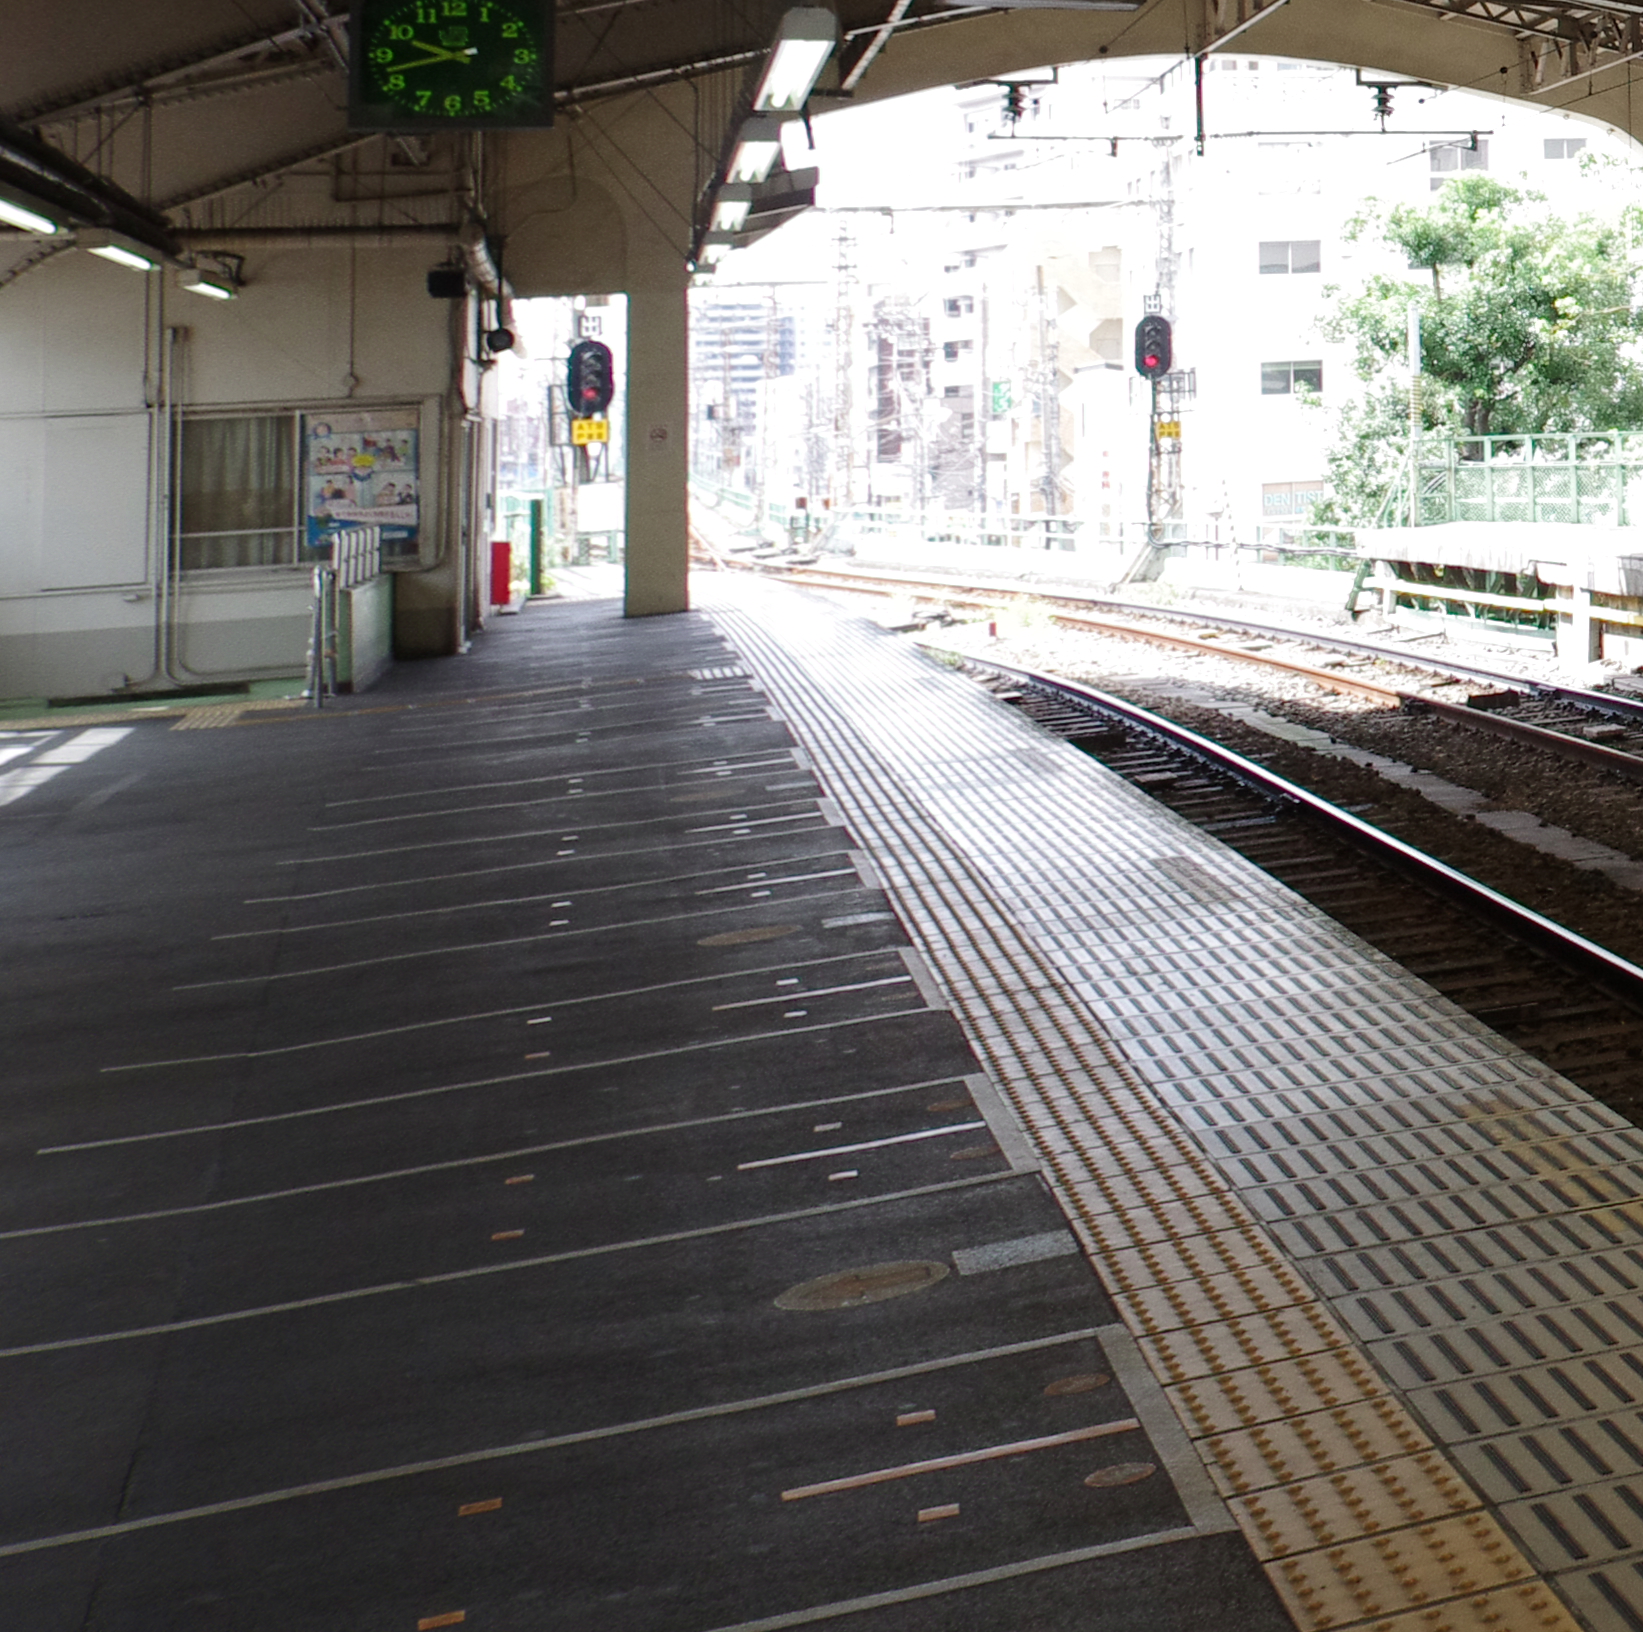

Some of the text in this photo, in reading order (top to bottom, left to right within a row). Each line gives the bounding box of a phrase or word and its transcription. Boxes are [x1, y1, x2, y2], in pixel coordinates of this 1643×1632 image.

[416, 8, 437, 24] 11
[442, 1, 467, 16] 12
[480, 7, 490, 23] 1
[389, 24, 414, 40] 10
[502, 22, 518, 38] 2
[376, 47, 393, 63] 9
[514, 48, 530, 64] 3
[389, 74, 405, 90] 8
[500, 75, 516, 91] 4
[415, 90, 432, 107] 7
[444, 95, 461, 112] 6
[473, 90, 490, 106] 5
